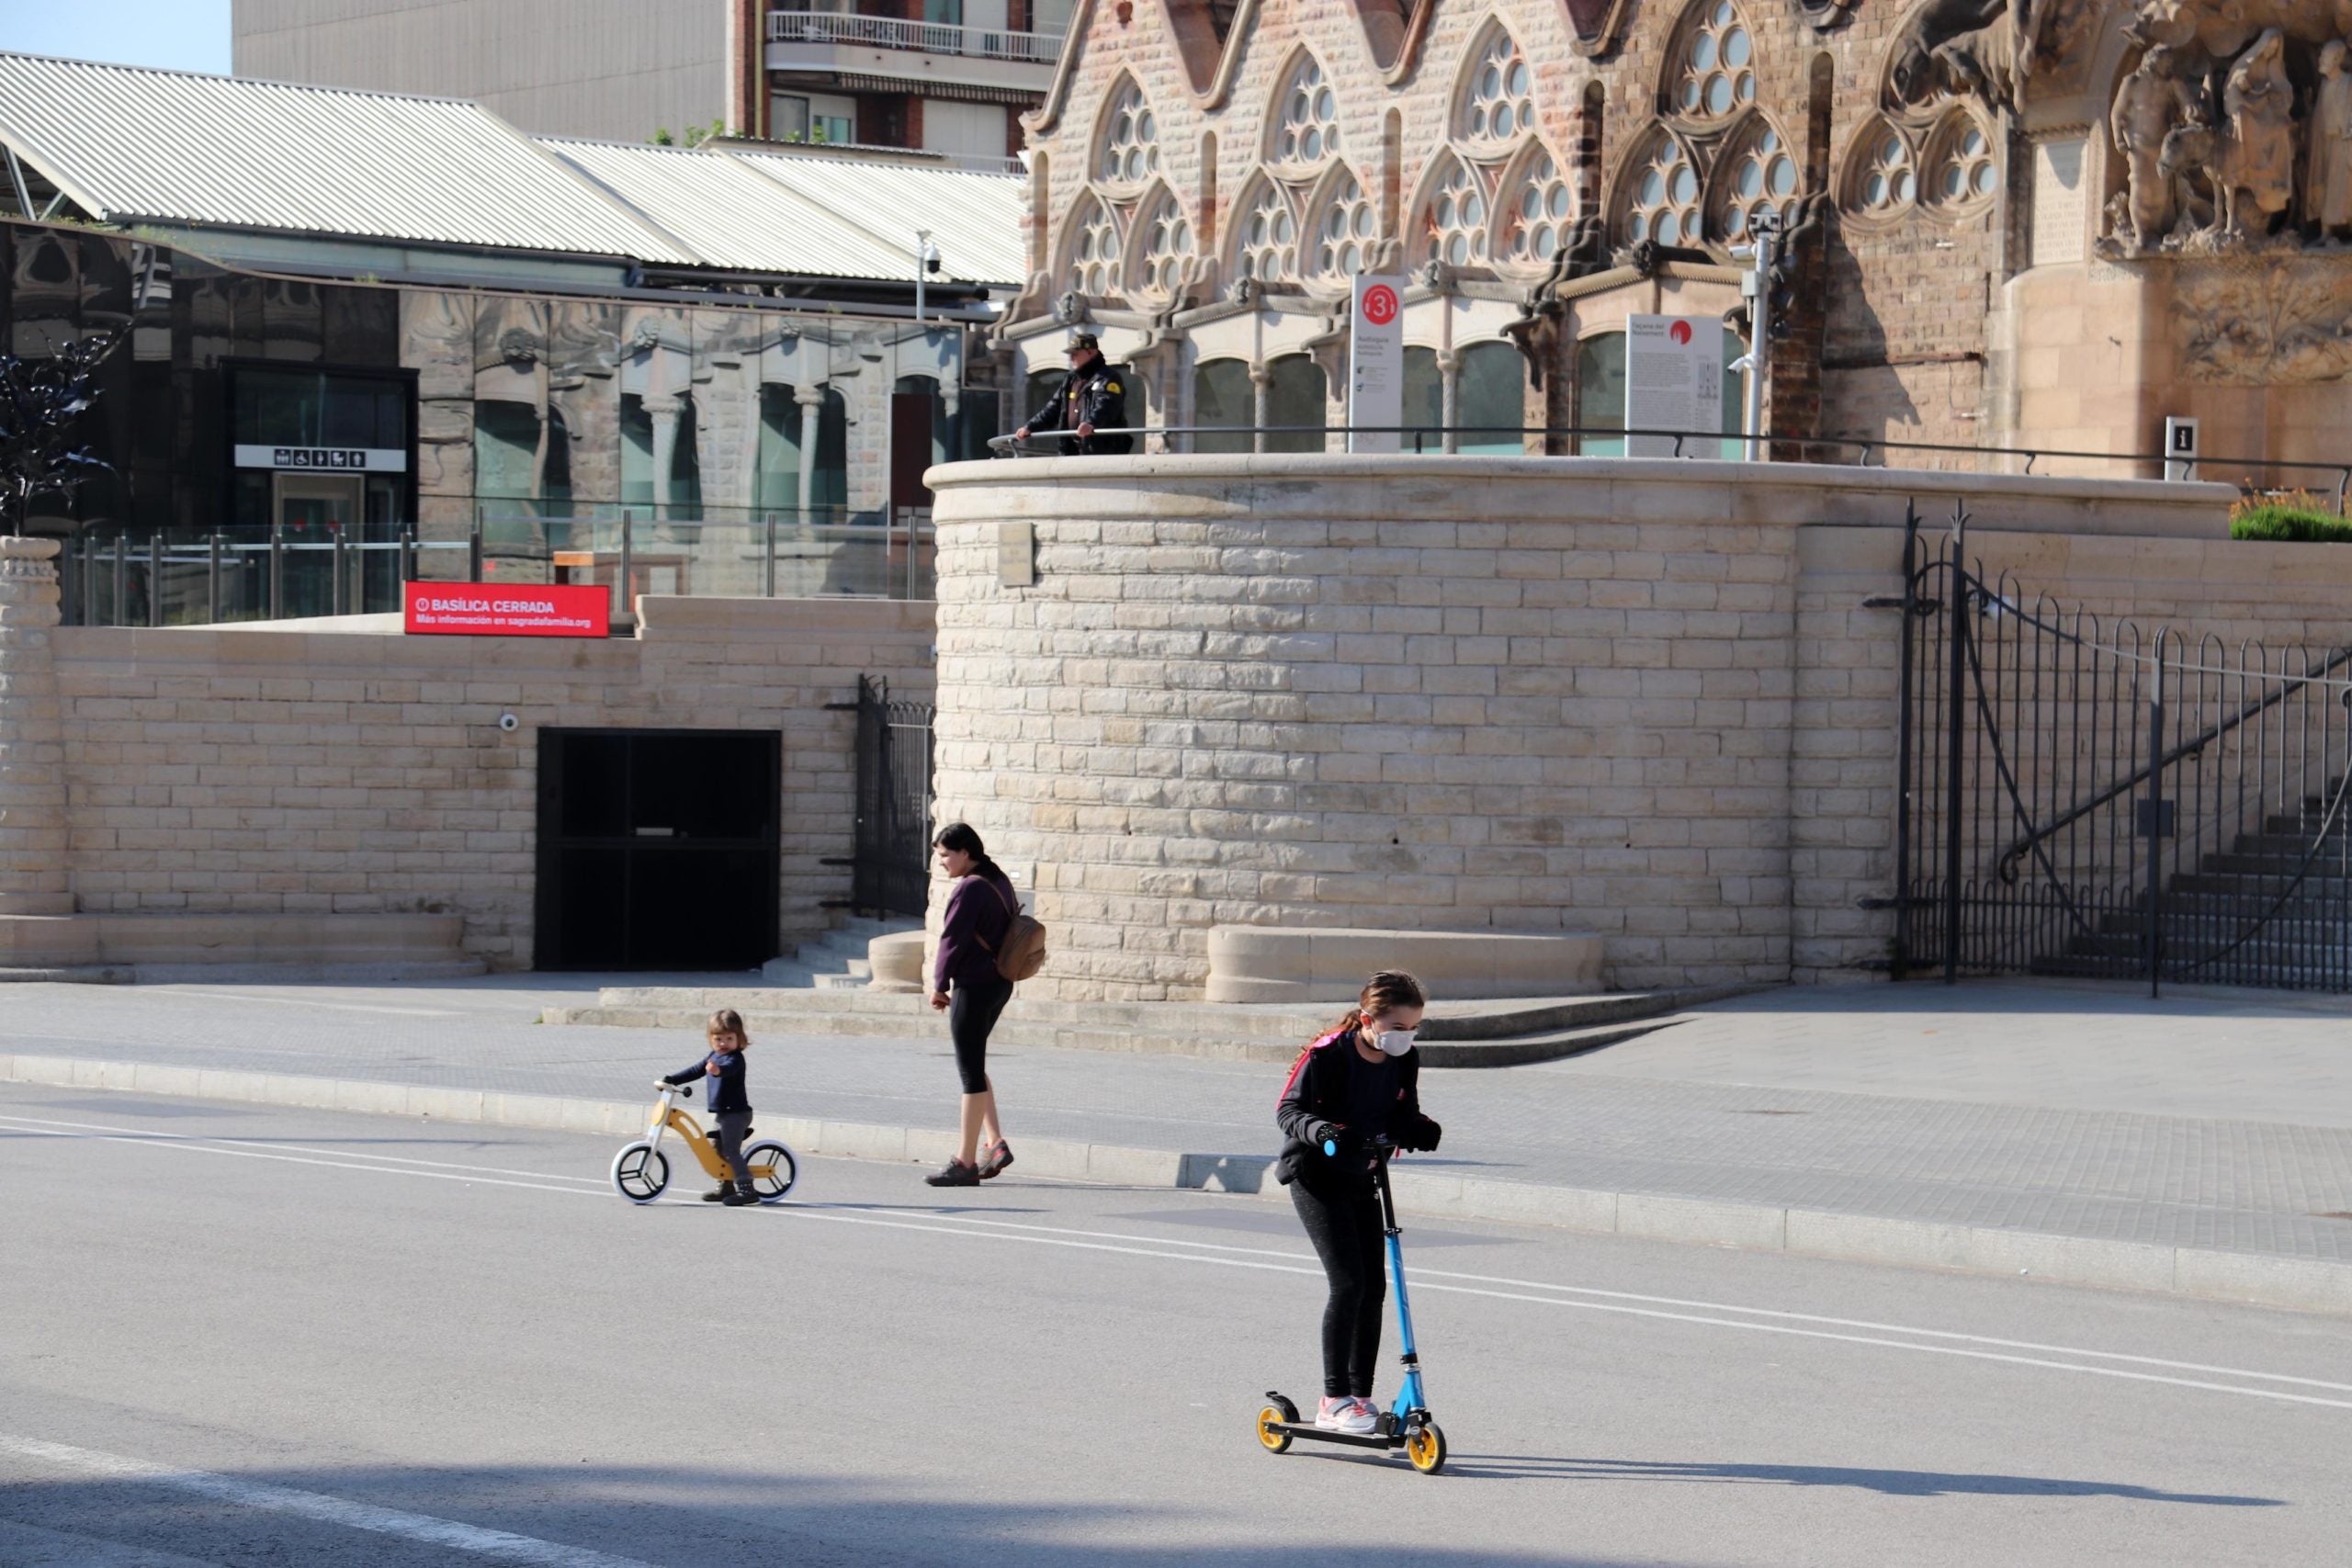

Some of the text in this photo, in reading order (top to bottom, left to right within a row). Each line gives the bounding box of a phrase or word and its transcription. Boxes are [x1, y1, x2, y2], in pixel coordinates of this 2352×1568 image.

[1373, 294, 1387, 317] 3
[432, 597, 555, 614] BASÍLICA CERRADA
[416, 613, 435, 624] Más
[437, 615, 492, 625] información
[508, 616, 591, 628] sagradafamilia.org
